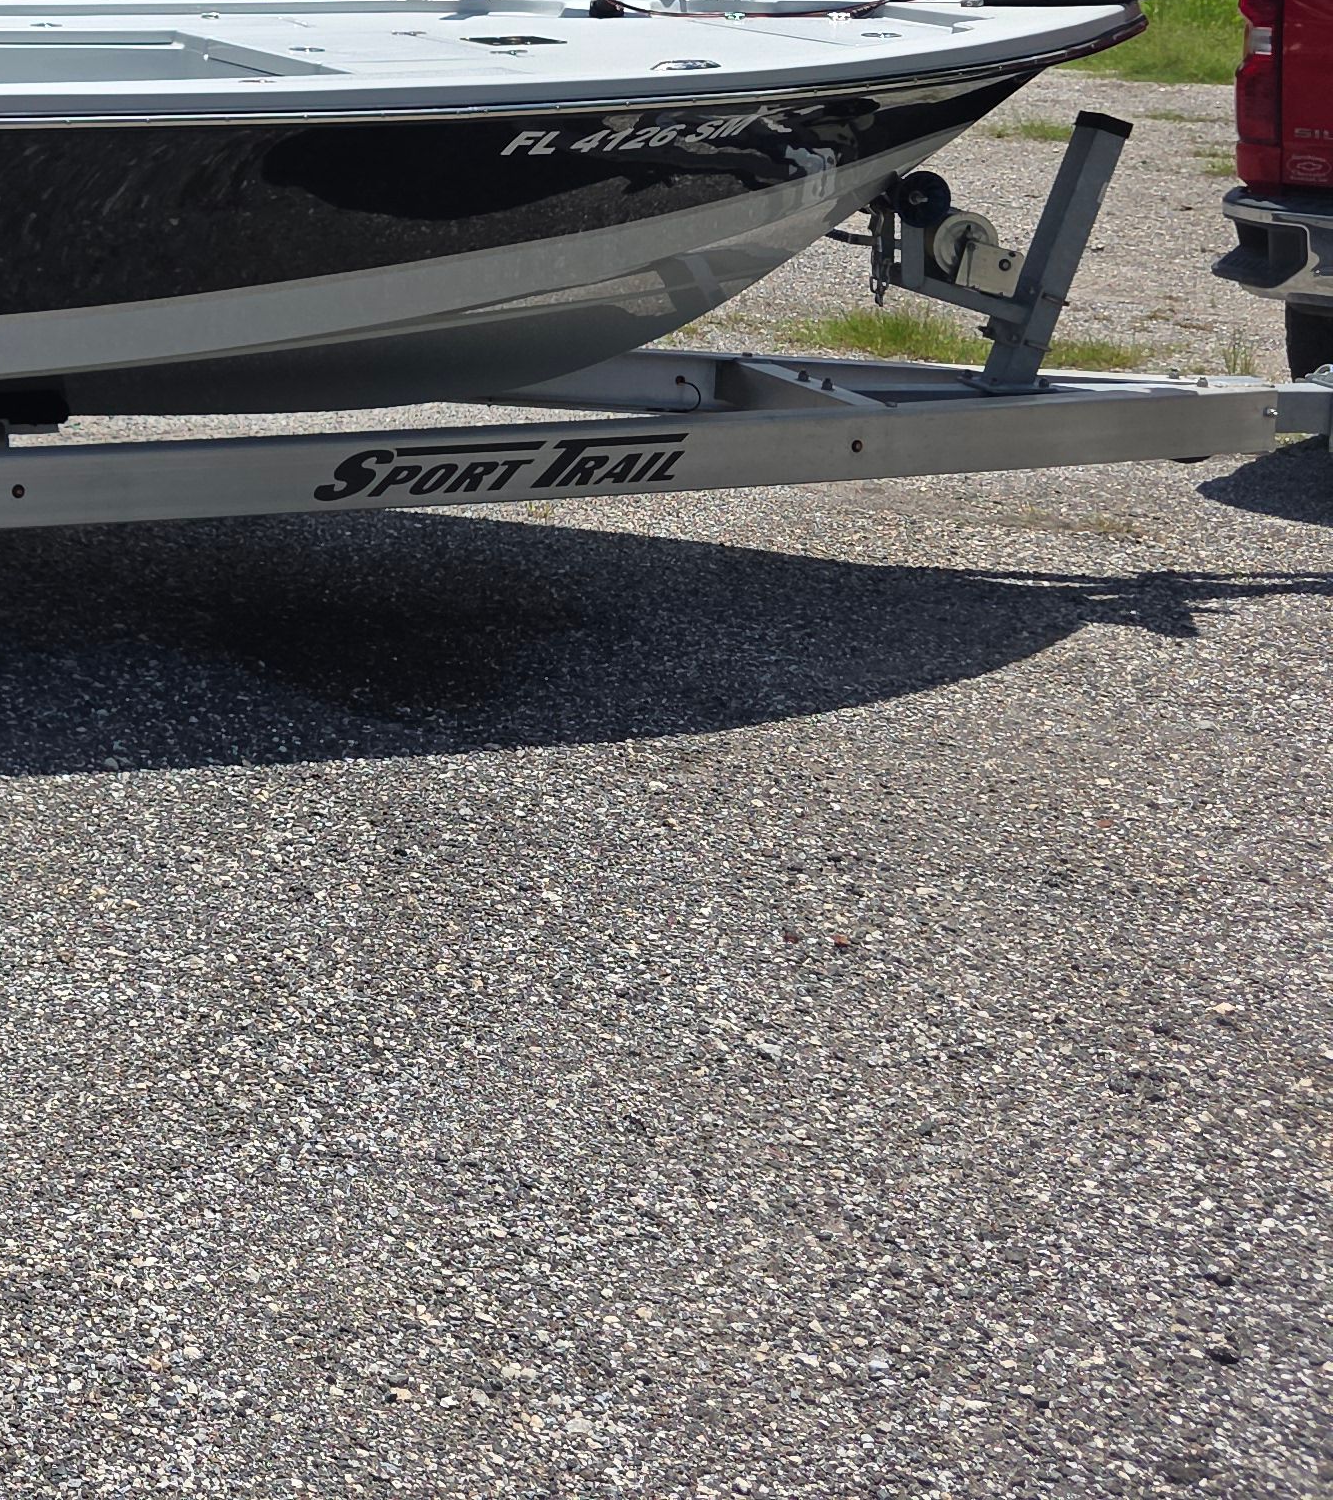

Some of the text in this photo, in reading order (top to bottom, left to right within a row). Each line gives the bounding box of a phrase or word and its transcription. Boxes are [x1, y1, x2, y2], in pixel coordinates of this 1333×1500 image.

[500, 130, 561, 156] FL
[570, 124, 684, 153] 4126
[313, 432, 689, 501] SPORT TRAIL
